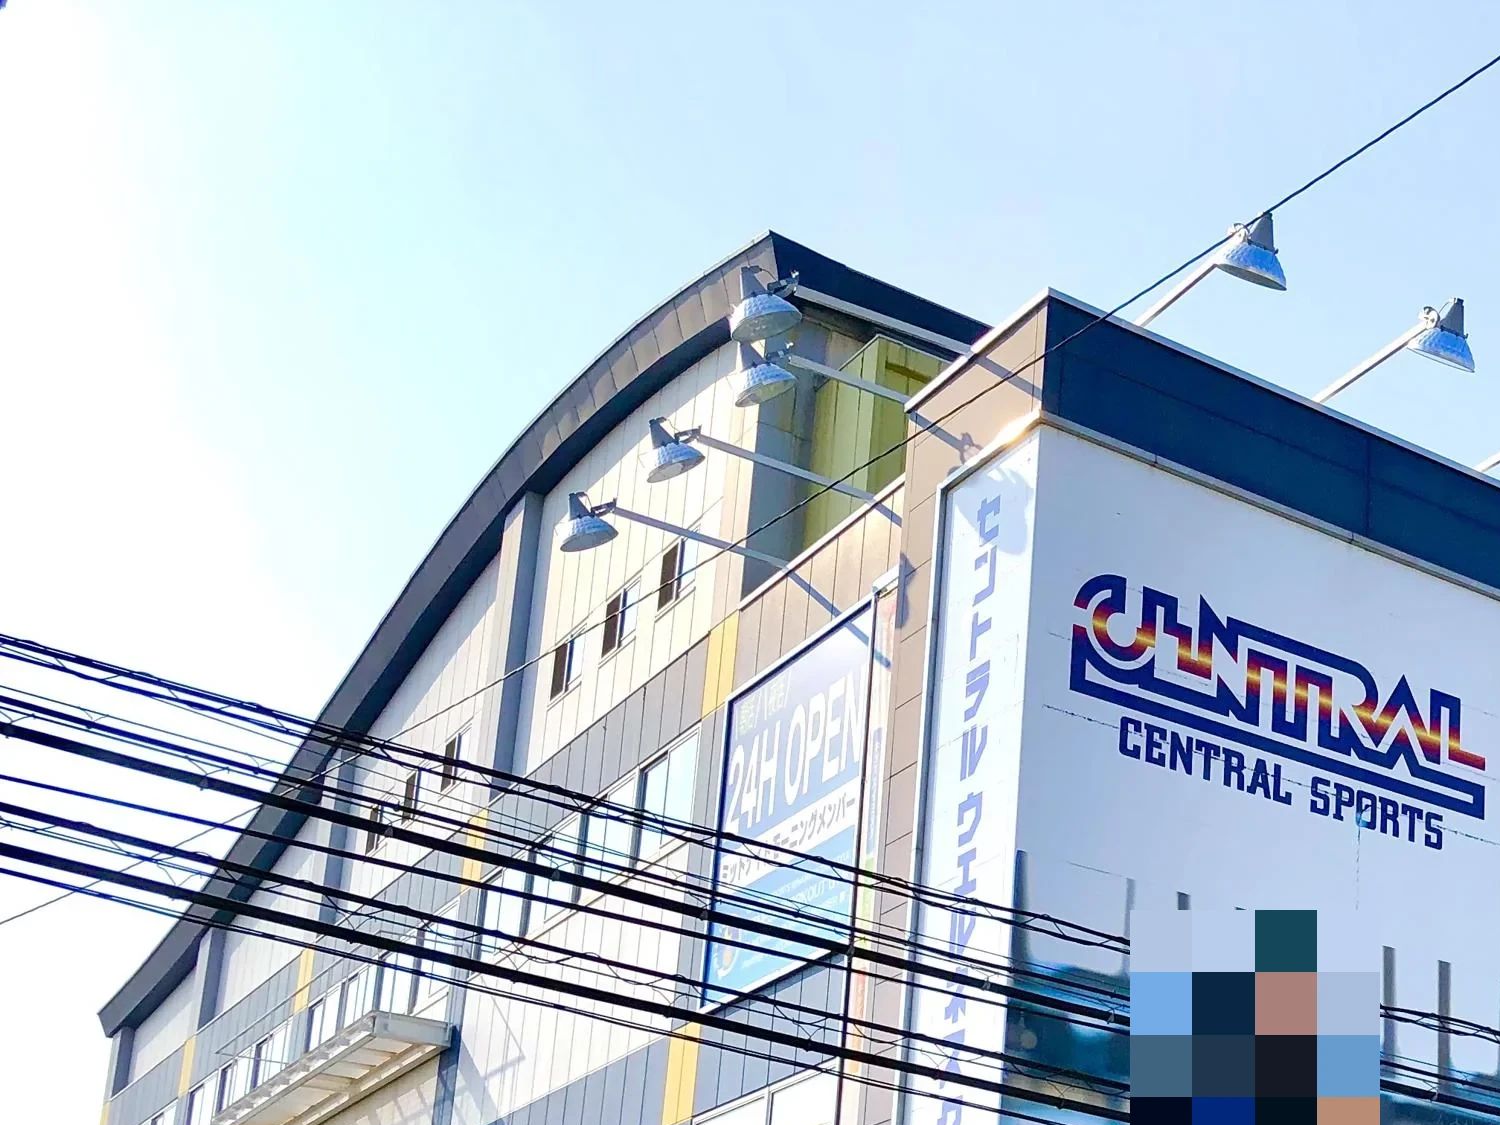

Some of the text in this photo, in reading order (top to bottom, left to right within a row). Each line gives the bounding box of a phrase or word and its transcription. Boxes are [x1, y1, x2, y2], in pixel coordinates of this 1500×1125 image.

[722, 720, 780, 835] 24H
[784, 663, 868, 805] OPEN
[1069, 574, 1486, 820] CENTRAL
[1119, 716, 1443, 850] CENTRAL SPORTS
